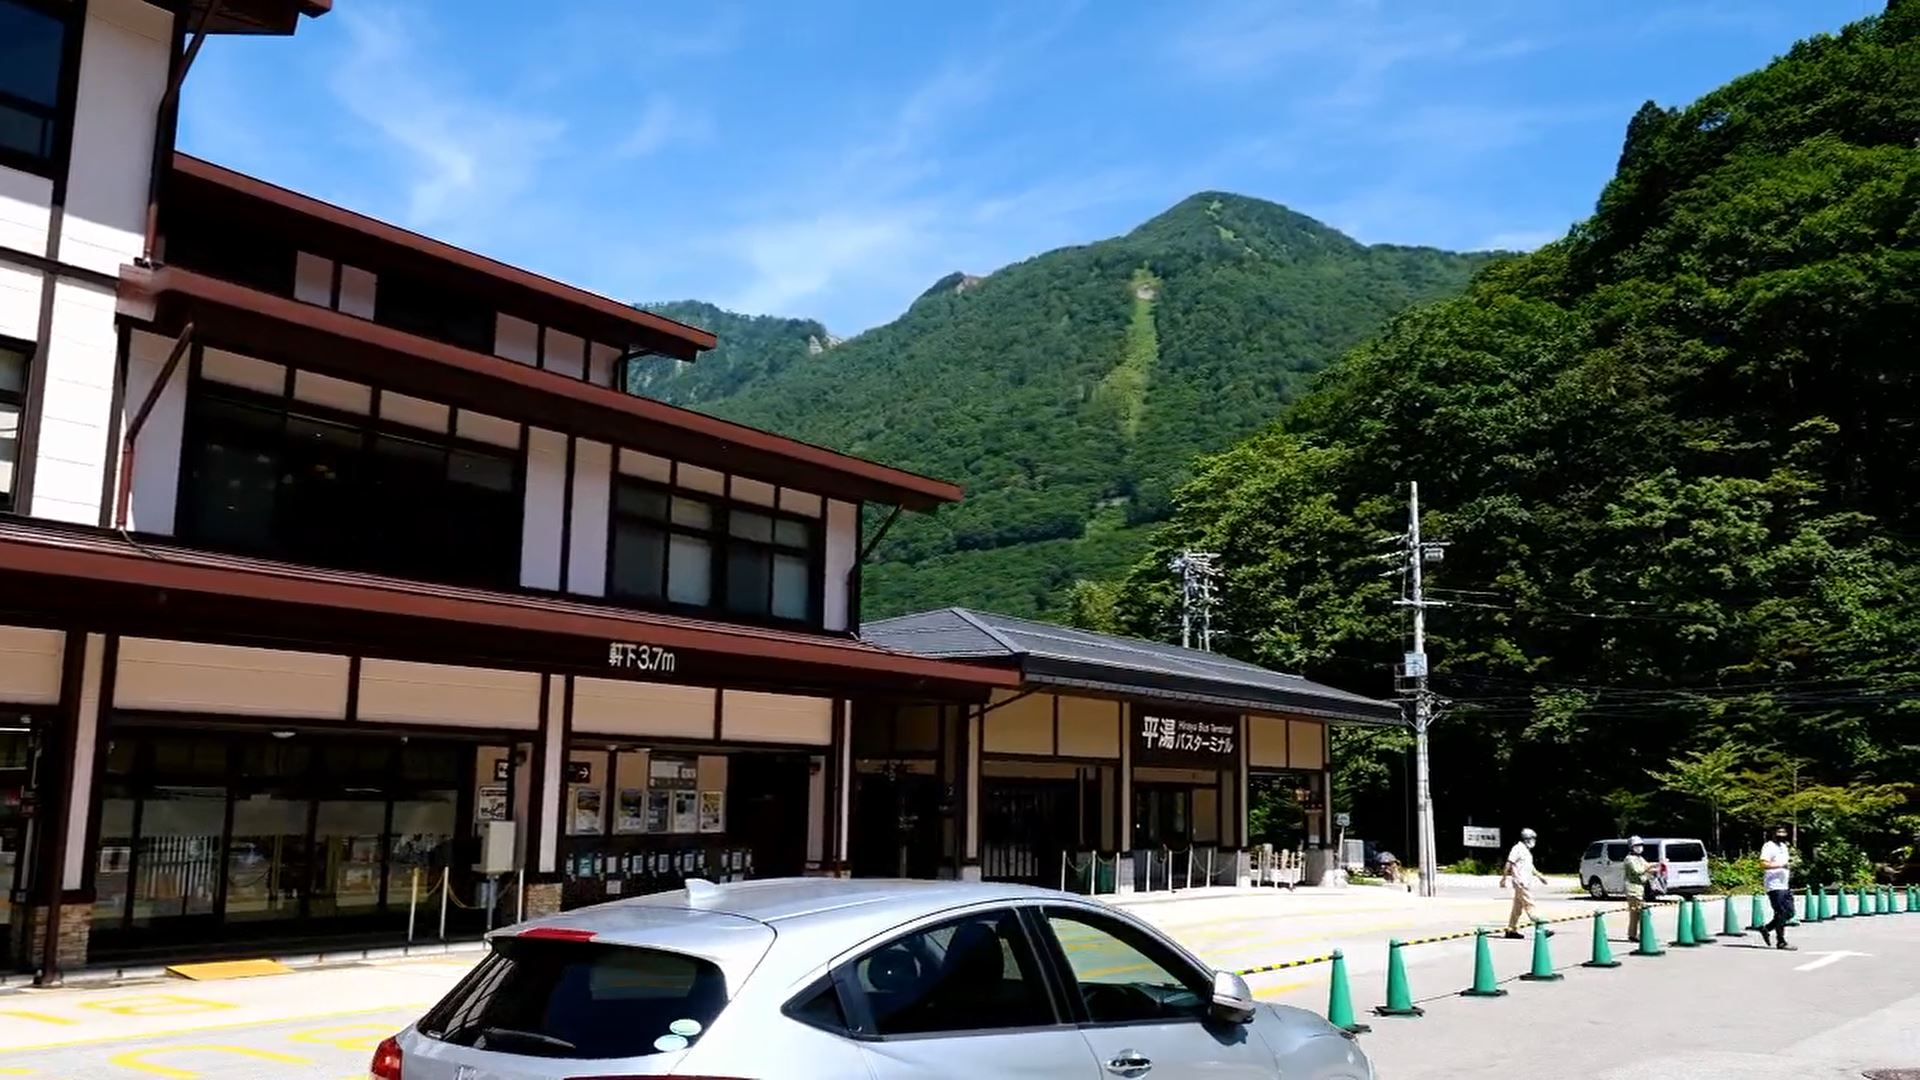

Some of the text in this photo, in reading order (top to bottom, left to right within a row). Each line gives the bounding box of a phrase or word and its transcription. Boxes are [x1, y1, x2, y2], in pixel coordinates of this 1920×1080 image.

[608, 642, 675, 672] 軒下3.7m
[1142, 716, 1176, 749] 平湯
[1199, 722, 1209, 732] Bus
[1175, 733, 1233, 753] バスターミナル
